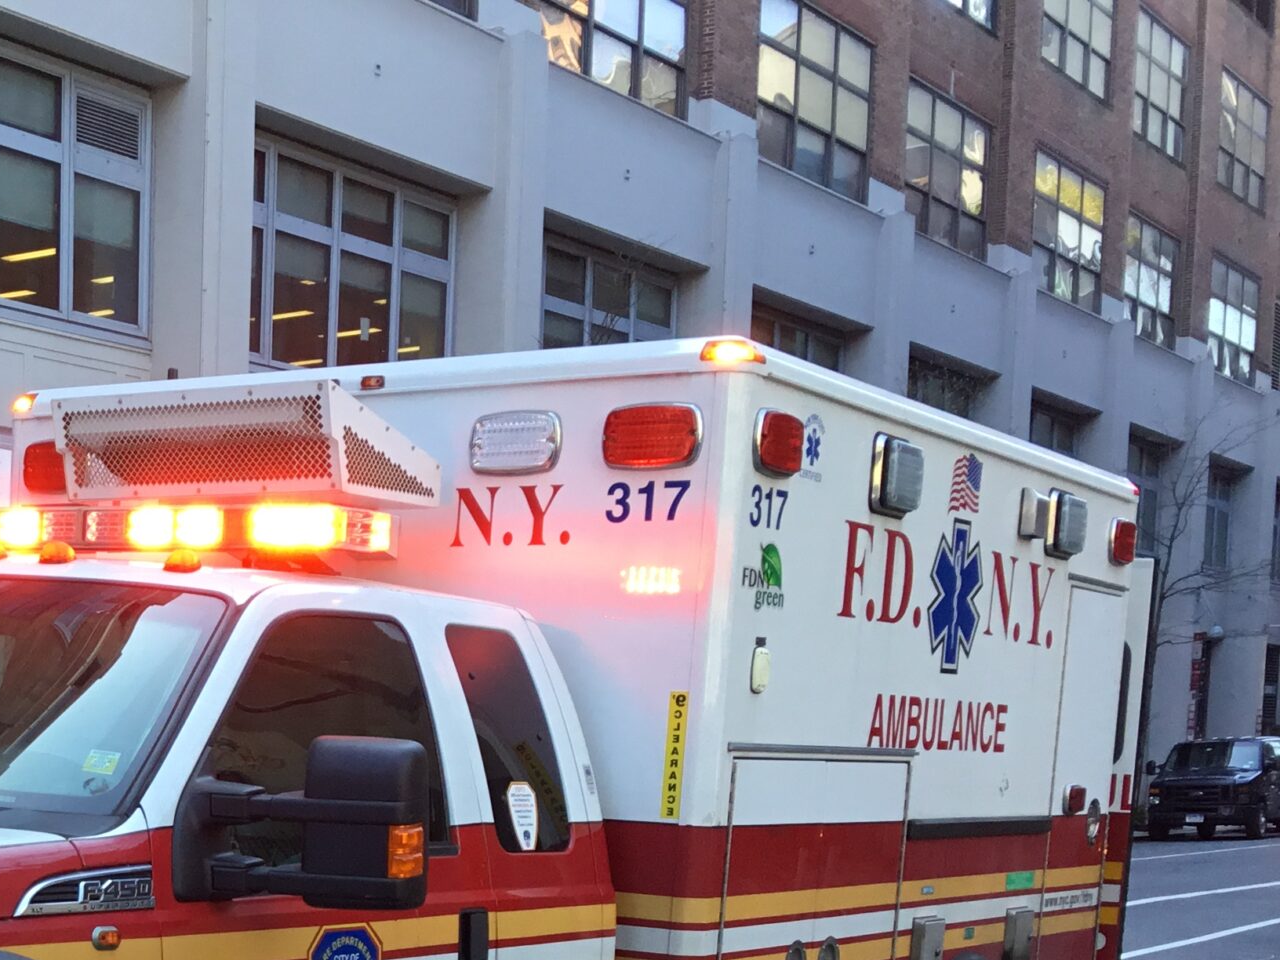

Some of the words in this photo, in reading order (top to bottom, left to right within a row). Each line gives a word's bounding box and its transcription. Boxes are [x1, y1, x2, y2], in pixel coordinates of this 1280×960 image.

[450, 484, 571, 547] N.Y.
[605, 480, 691, 523] 317
[749, 485, 789, 530] 317
[754, 589, 785, 610] green
[837, 520, 921, 628] F.D.
[983, 551, 1055, 649] N.Y.
[867, 693, 1008, 753] AMBULANCE
